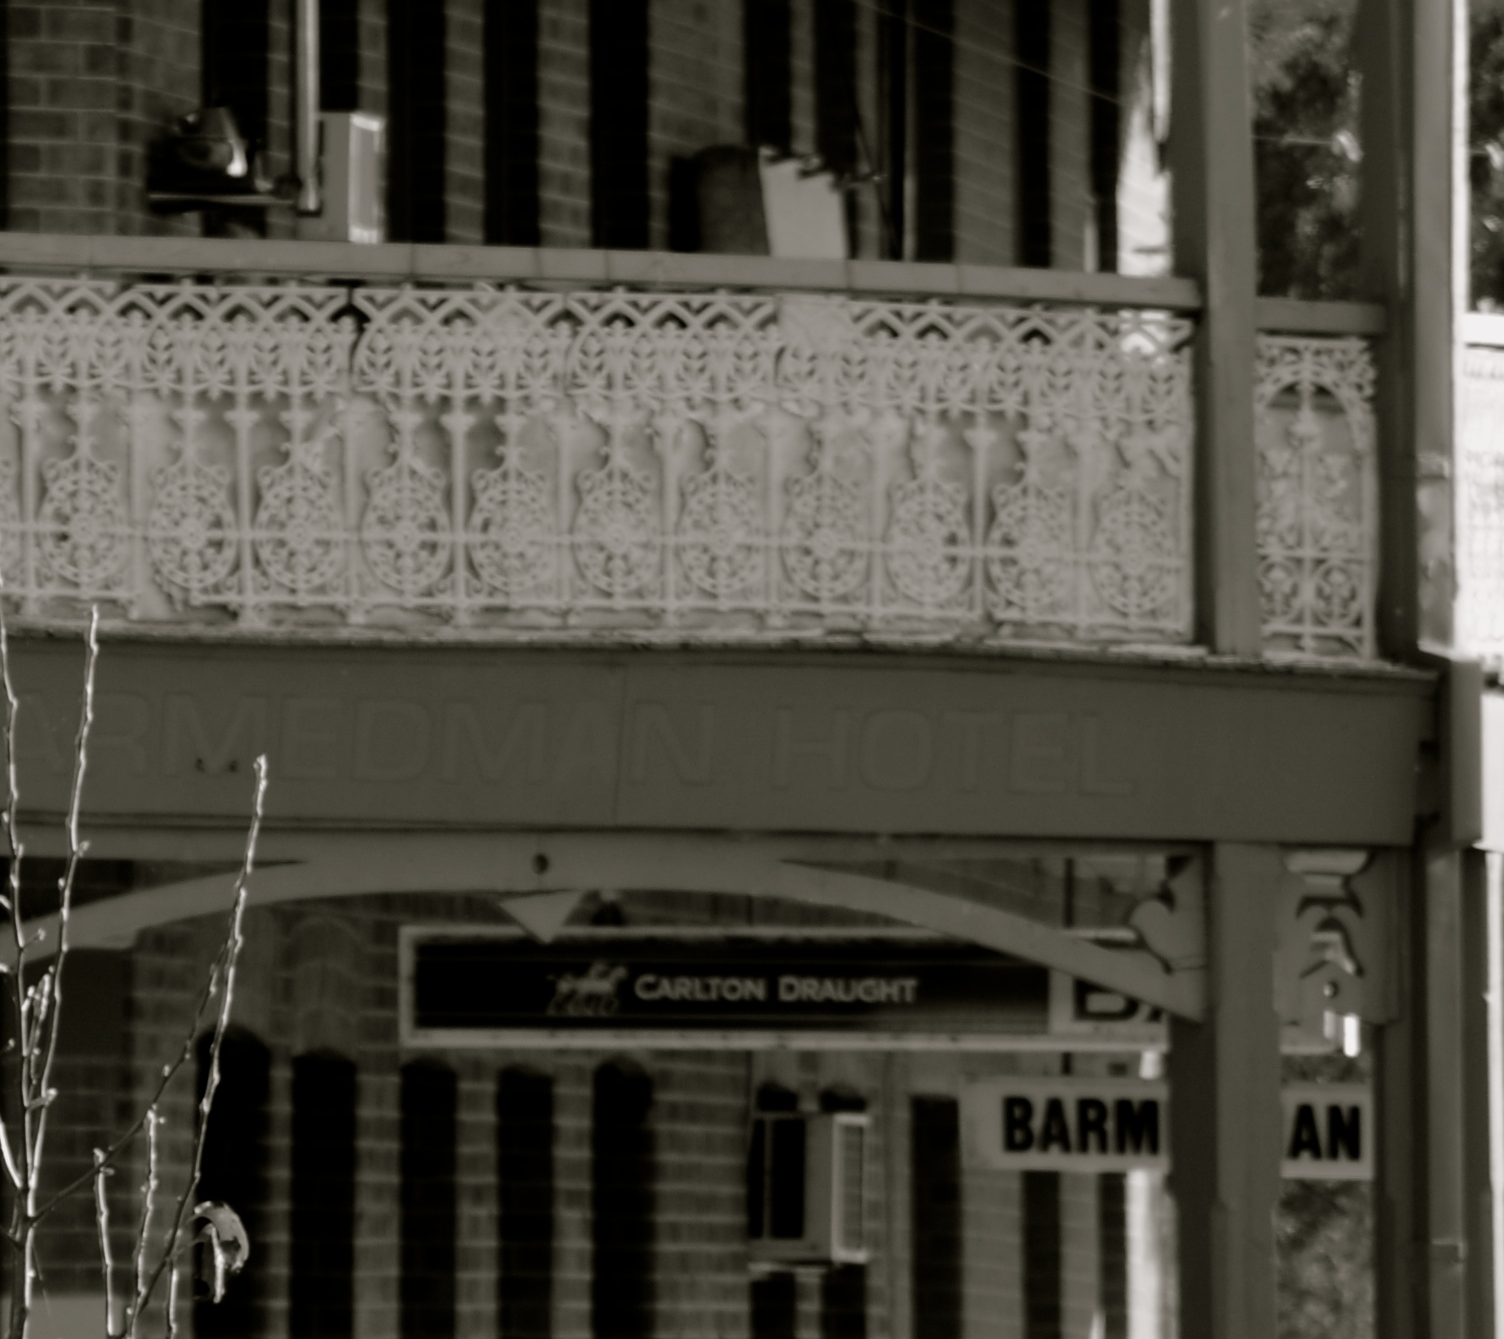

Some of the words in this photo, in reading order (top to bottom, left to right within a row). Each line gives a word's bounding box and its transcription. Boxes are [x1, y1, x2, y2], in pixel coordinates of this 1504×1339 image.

[768, 701, 1141, 799] HOTEL
[634, 974, 766, 1002] CARLTON
[777, 974, 918, 1004] DRAUGHT
